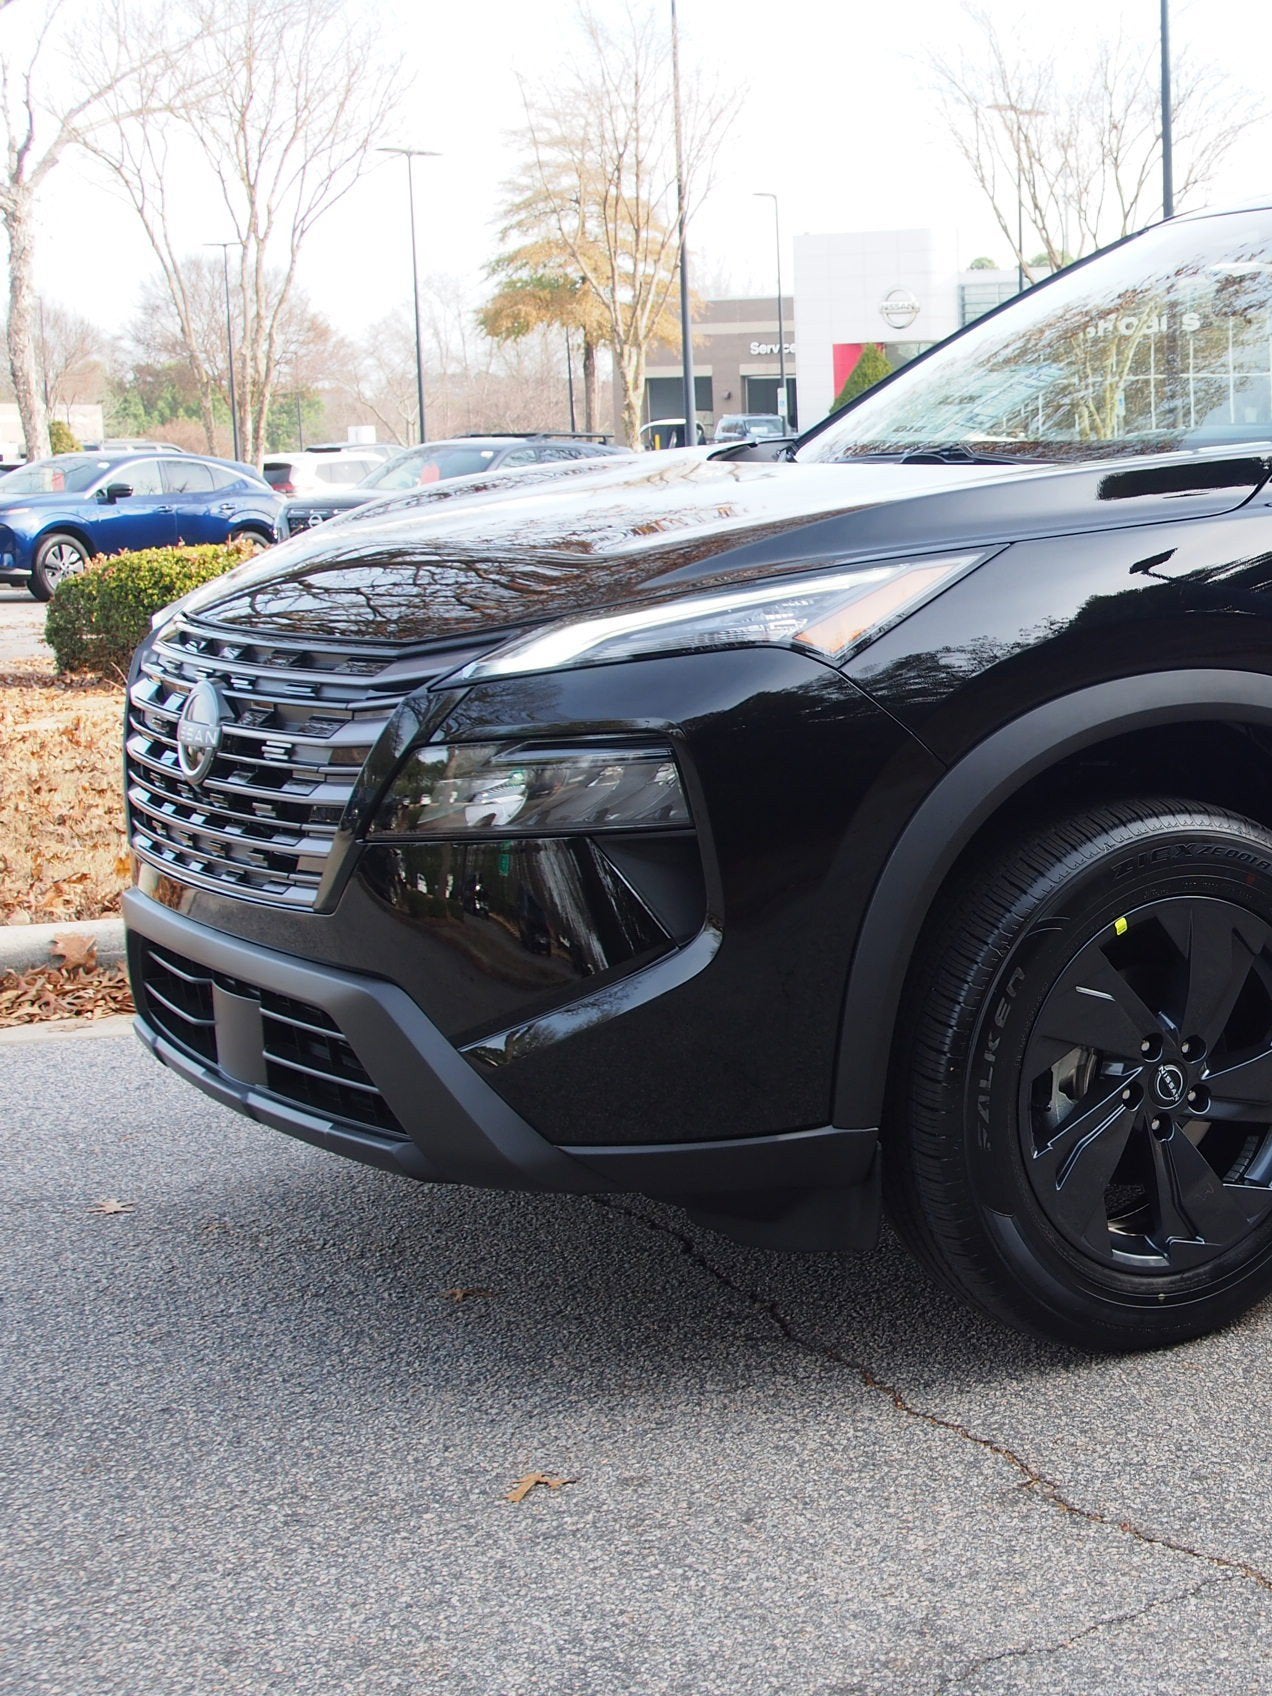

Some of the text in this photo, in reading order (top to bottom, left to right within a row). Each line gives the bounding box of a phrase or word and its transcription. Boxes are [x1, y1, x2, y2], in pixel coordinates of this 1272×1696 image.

[880, 302, 917, 312] NISSAN
[750, 342, 795, 356] Servce
[1111, 842, 1197, 880] ZIEX
[976, 965, 1026, 1152] FALKEN
[1158, 1064, 1180, 1102] NISSAN
